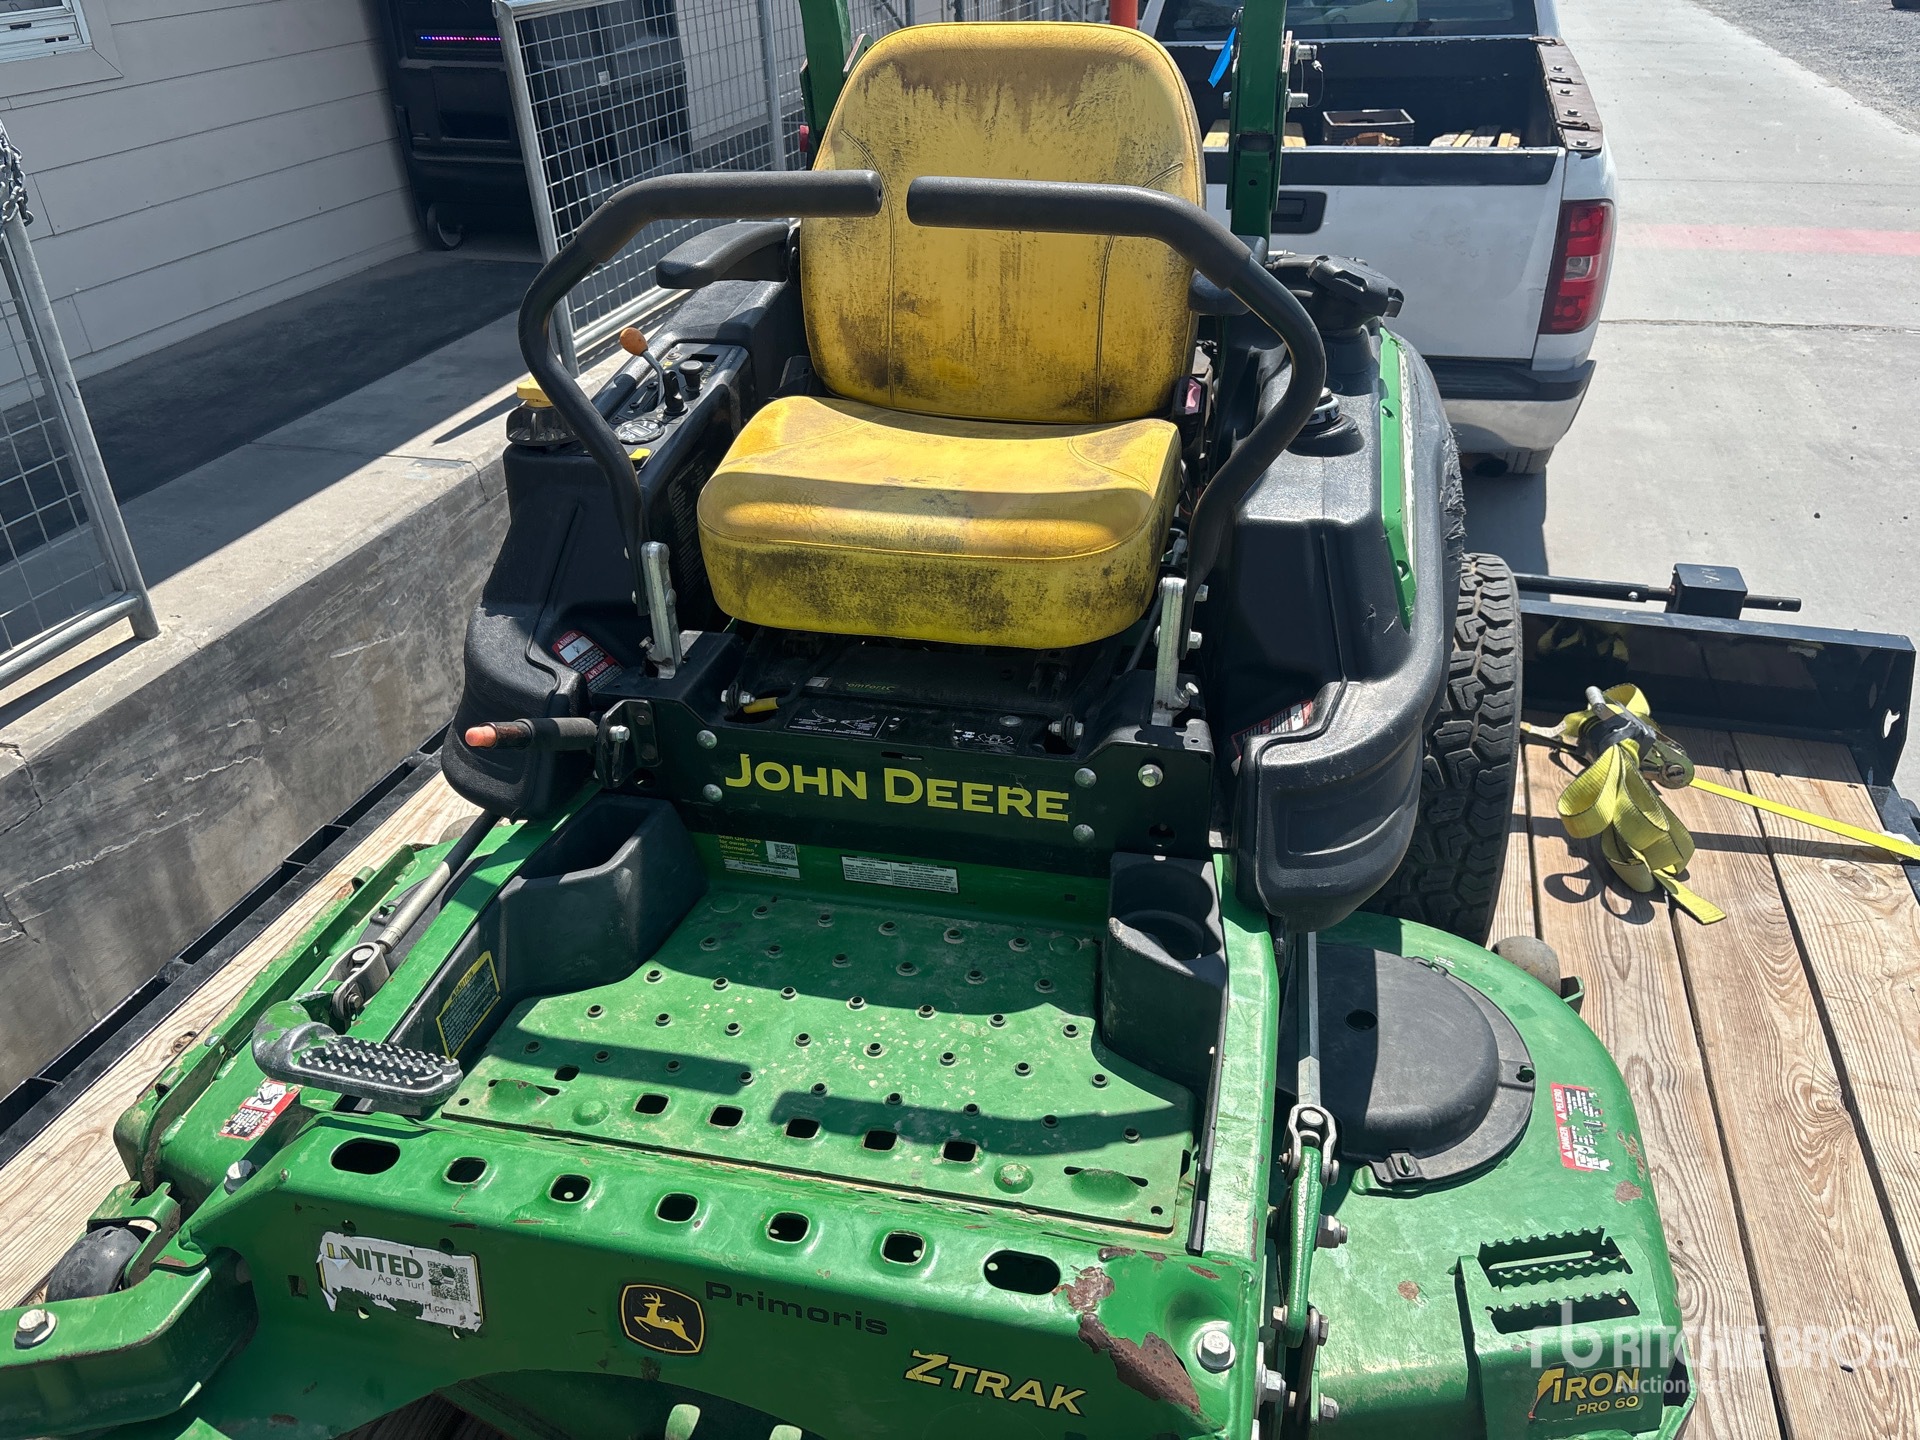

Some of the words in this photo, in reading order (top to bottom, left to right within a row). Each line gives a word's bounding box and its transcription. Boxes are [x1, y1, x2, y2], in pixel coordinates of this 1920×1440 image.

[560, 631, 579, 647] DANGER
[591, 661, 609, 678] PELIGRO
[725, 753, 867, 800] JOHN
[884, 768, 1070, 822] DEERE
[377, 1274, 392, 1286] Ag
[395, 1277, 403, 1287] &
[405, 1278, 425, 1291] Turf
[704, 1279, 889, 1337] Primoris
[904, 1349, 1087, 1416] ZTRAK
[1551, 1366, 1640, 1404] IRON
[1576, 1400, 1610, 1416] PRO
[1614, 1395, 1640, 1410] 60
